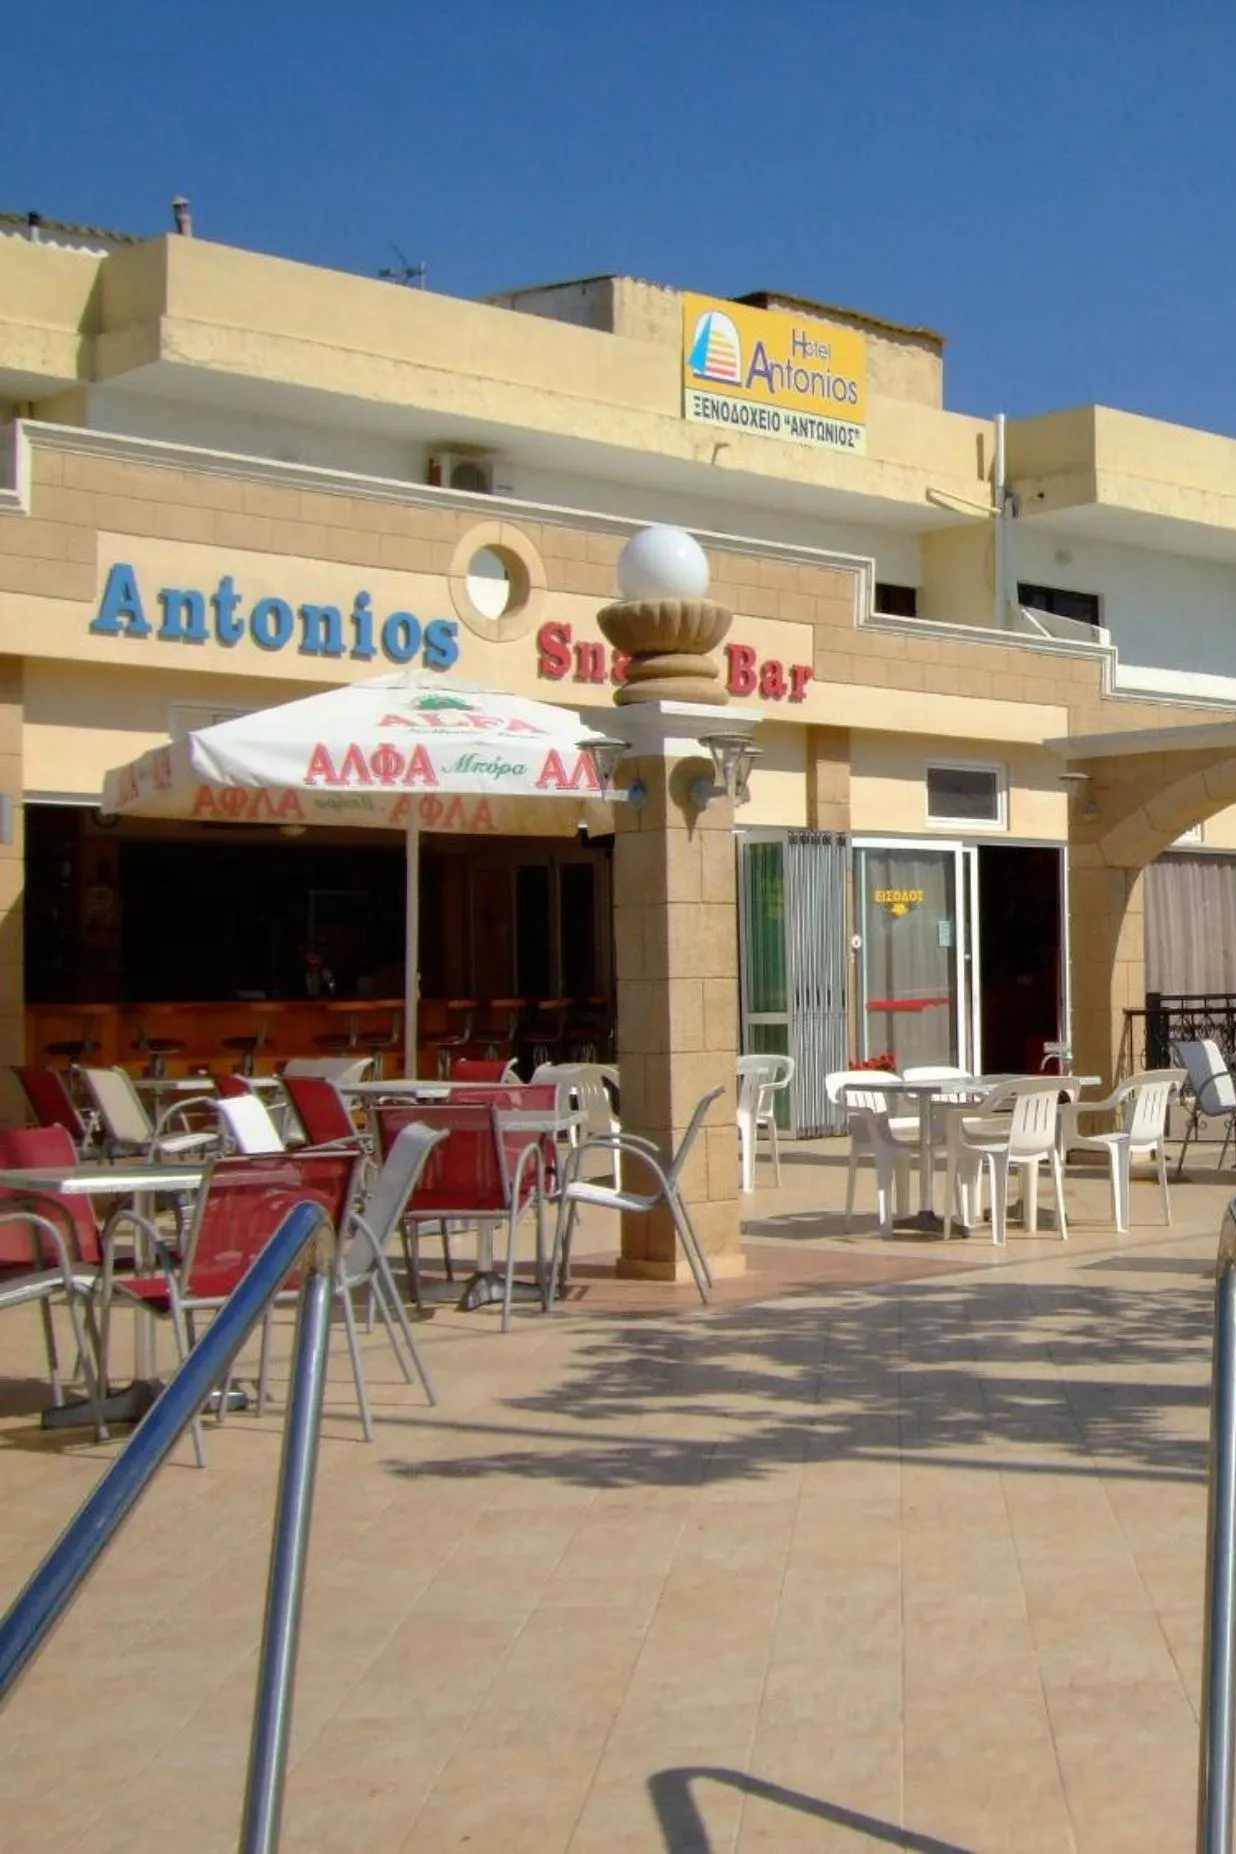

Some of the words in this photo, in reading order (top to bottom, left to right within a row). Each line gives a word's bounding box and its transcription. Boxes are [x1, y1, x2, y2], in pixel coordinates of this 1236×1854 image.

[791, 328, 832, 360] Hotel
[745, 340, 858, 404] Antonios
[693, 395, 781, 432] ΞΕΝΟΔΟΧΕΙΟ
[89, 562, 461, 671] Antonios
[537, 621, 631, 685] Sna
[724, 643, 814, 703] Bar
[303, 742, 440, 786] ΑΛΦΑ
